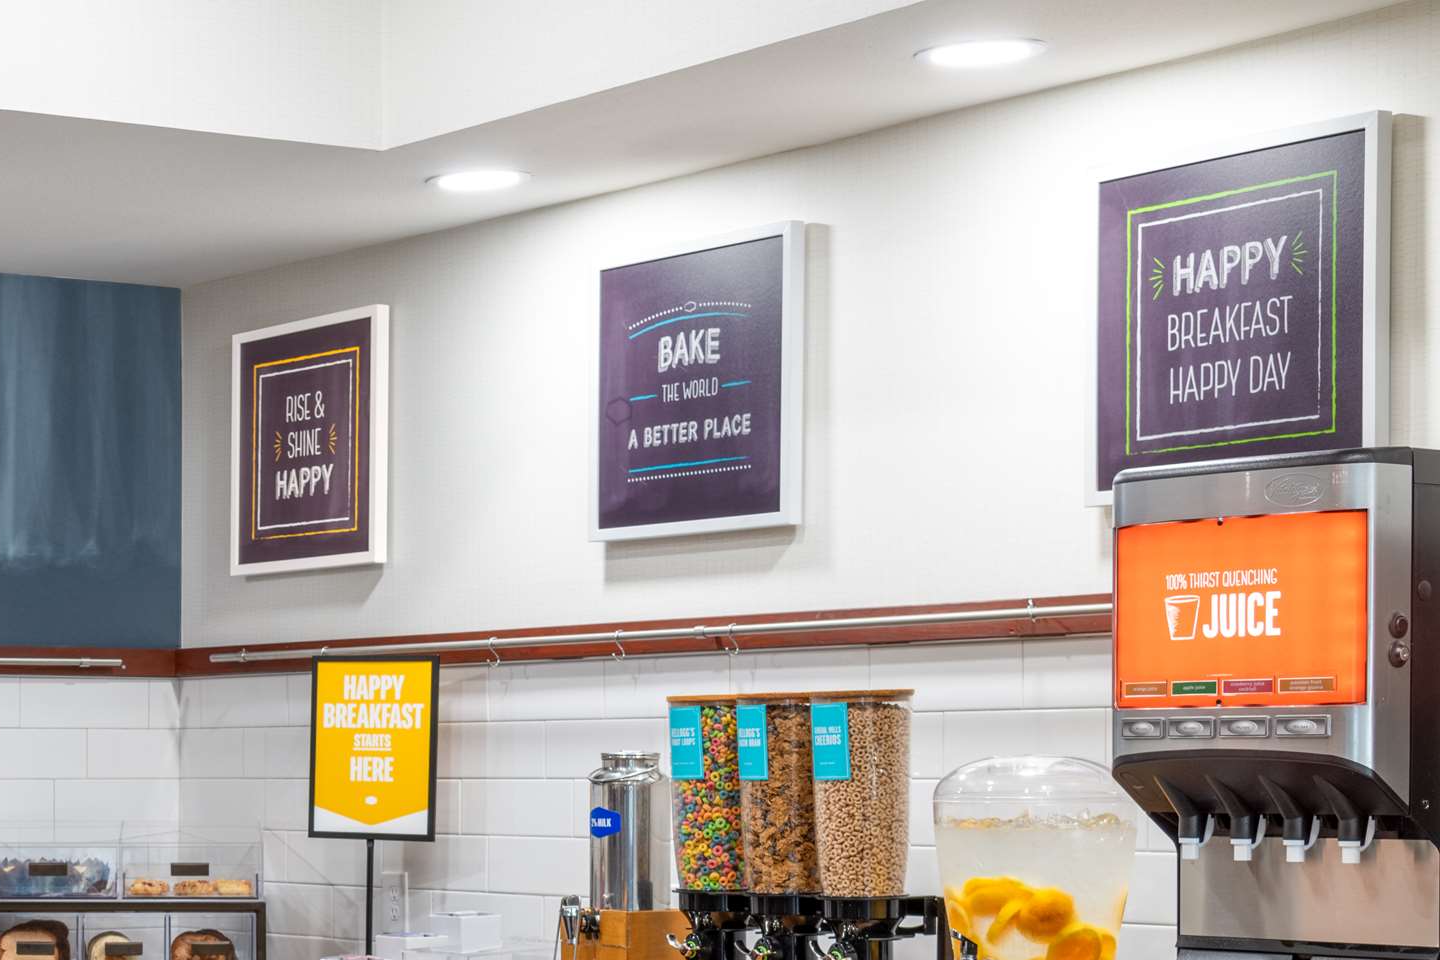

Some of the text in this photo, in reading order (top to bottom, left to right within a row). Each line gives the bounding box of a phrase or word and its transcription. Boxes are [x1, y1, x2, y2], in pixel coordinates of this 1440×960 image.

[1172, 235, 1288, 296] HAPPY
[1167, 295, 1293, 351] BREAKFAST
[657, 327, 721, 373] BAKE
[661, 377, 719, 402] THE WORLD
[1169, 351, 1291, 404] HAPPY DAY
[285, 390, 325, 423] RISE &
[287, 428, 322, 459] SHINE
[627, 413, 752, 450] A BETTER PLACE
[275, 463, 334, 500] HAPPY
[1165, 567, 1278, 590] 100% THIRST QUENCHING
[1202, 590, 1281, 639] JUICE
[343, 674, 405, 701] HAPPY
[322, 703, 424, 729] BREAKFAST
[353, 733, 392, 748] STARTS
[350, 756, 394, 782] HERE
[597, 817, 611, 828] MILK
